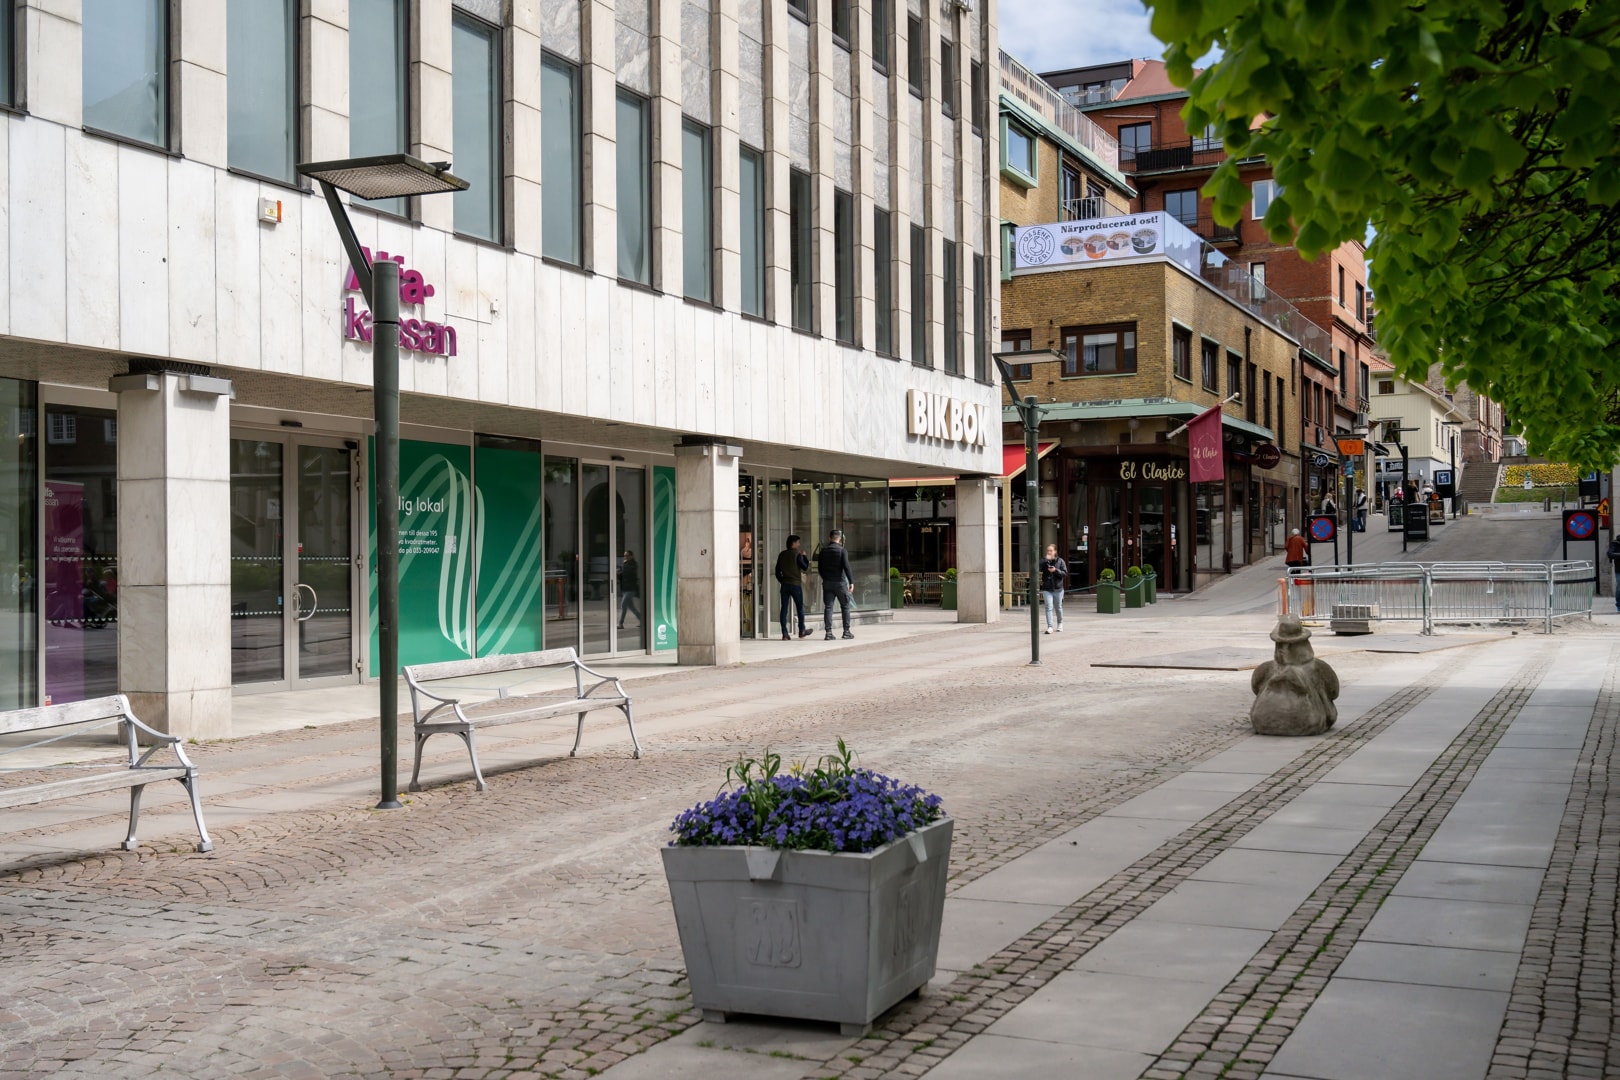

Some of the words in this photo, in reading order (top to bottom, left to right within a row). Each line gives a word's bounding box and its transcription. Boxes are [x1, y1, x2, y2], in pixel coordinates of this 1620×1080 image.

[1061, 218, 1136, 233] Närproducerad
[1140, 216, 1158, 226] ost!
[345, 297, 457, 356] ksan
[1120, 461, 1136, 480] El
[1142, 462, 1185, 480] Clasico
[416, 496, 443, 512] lokal
